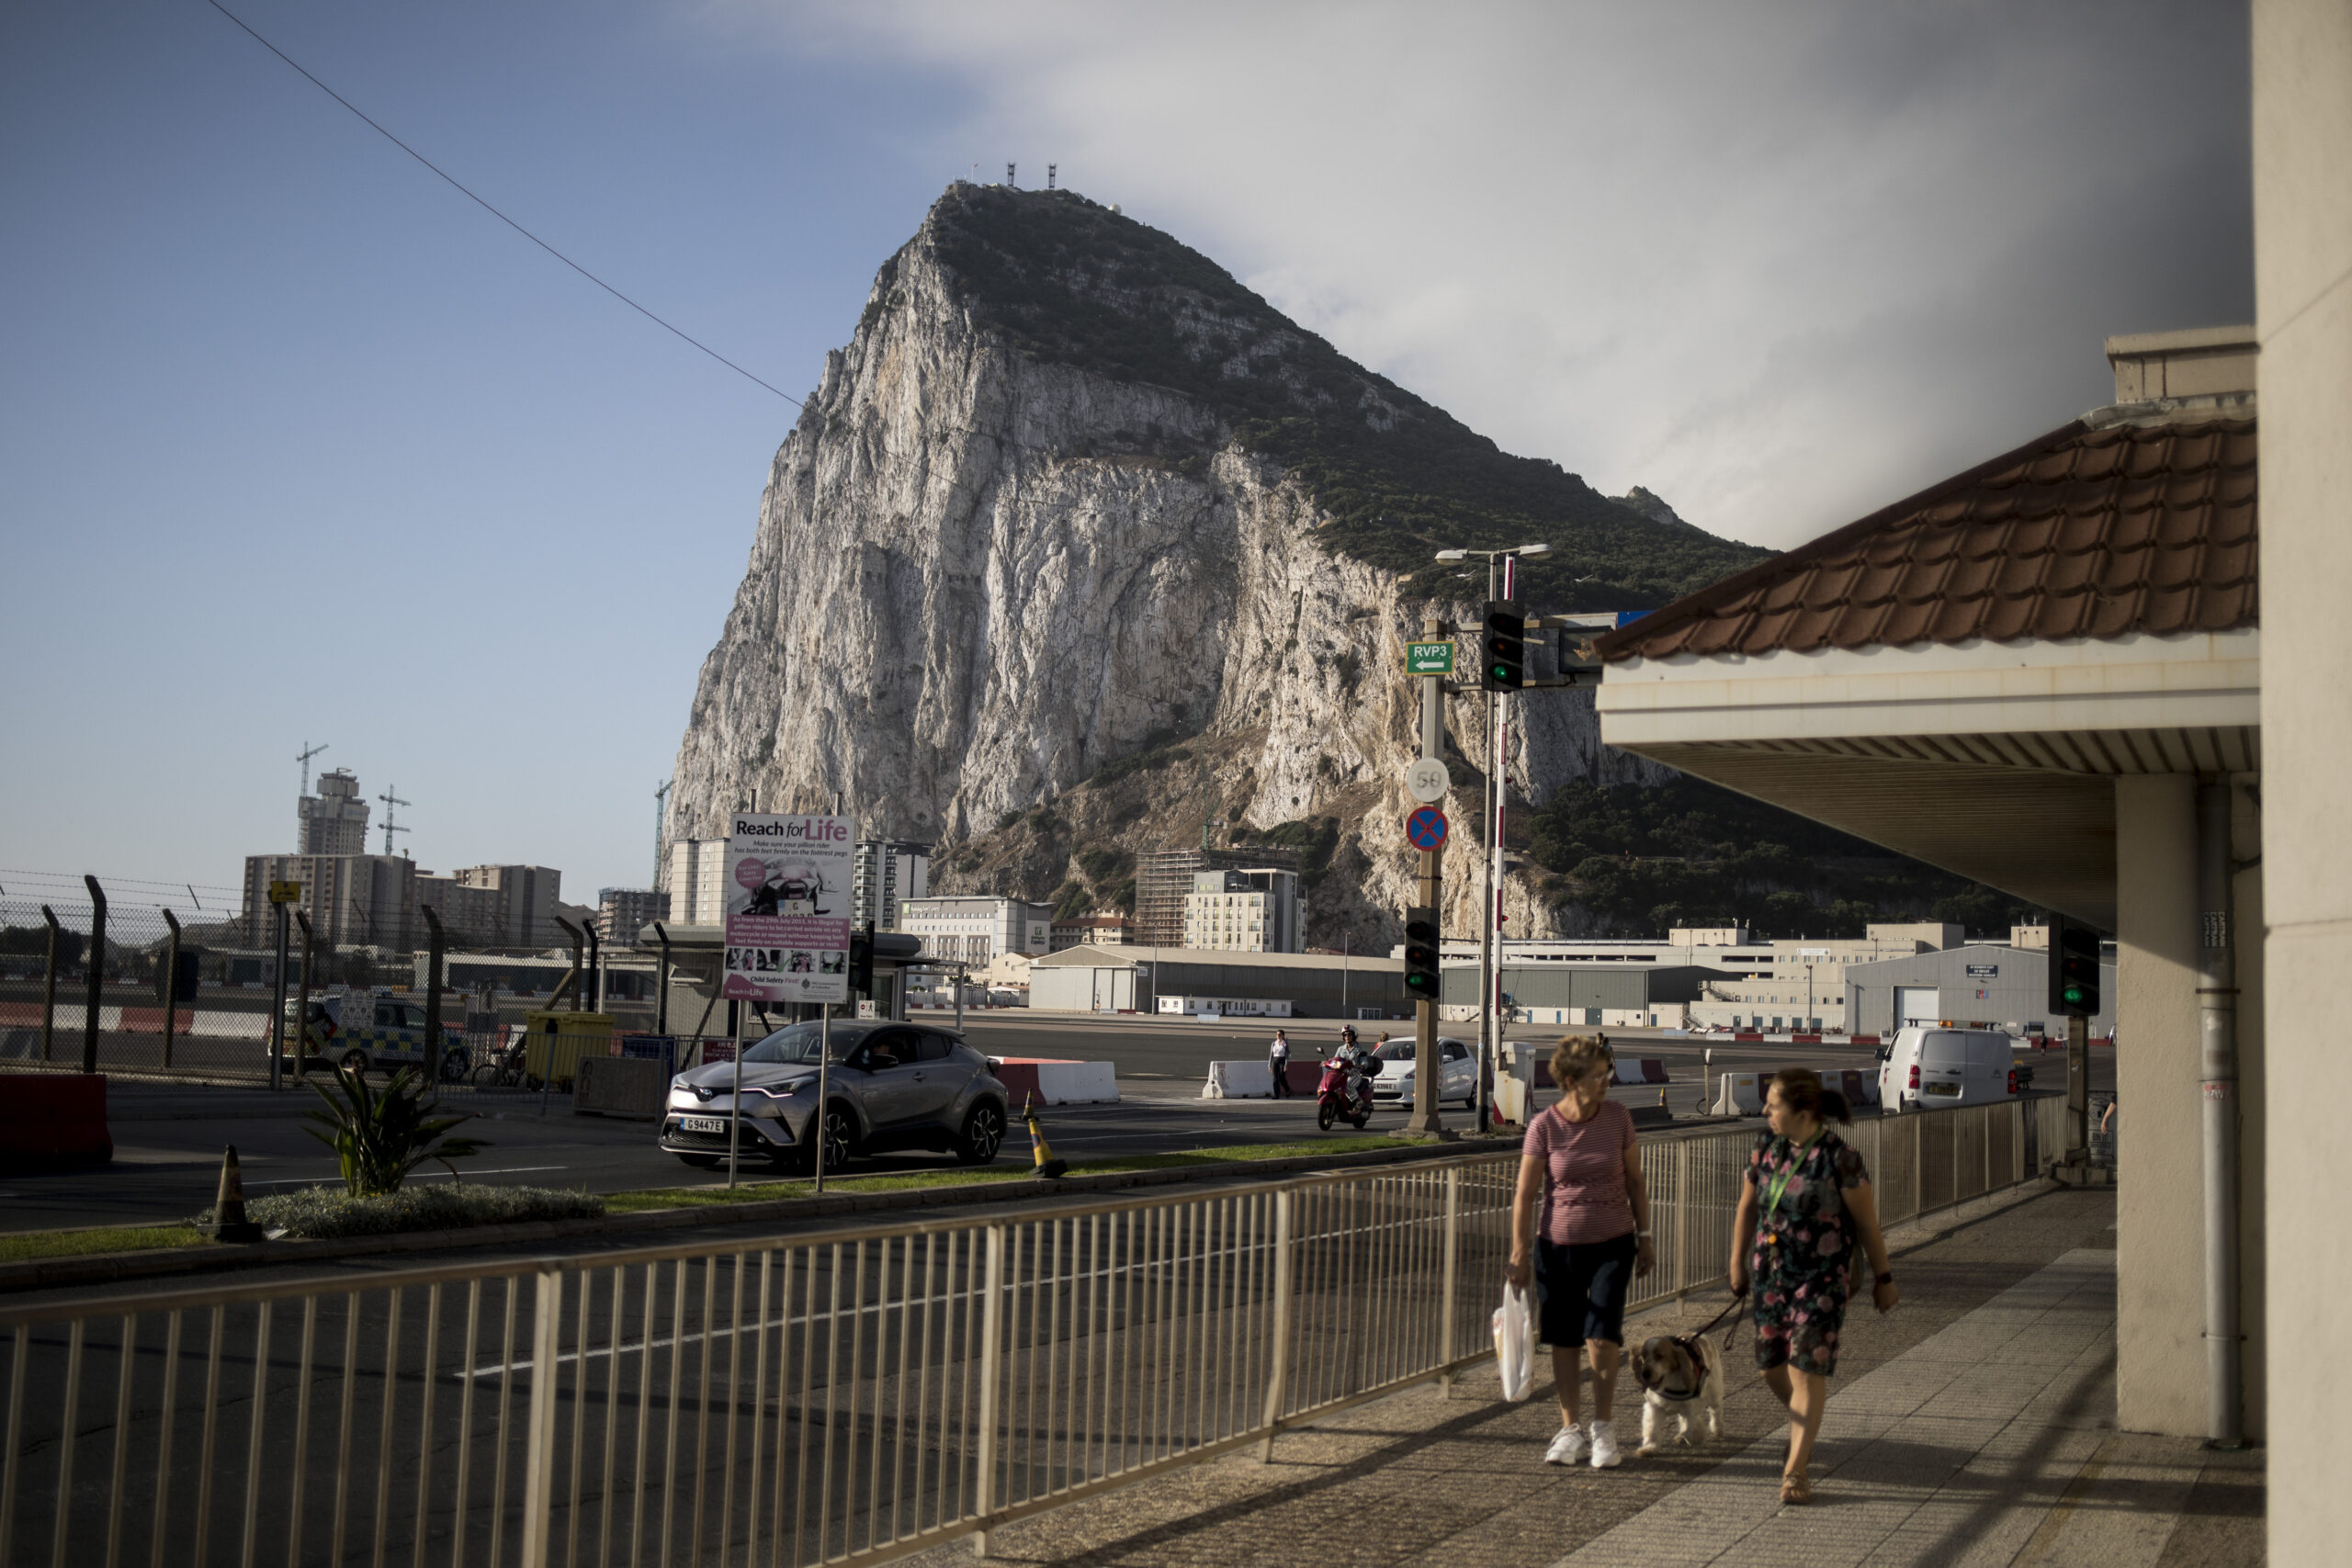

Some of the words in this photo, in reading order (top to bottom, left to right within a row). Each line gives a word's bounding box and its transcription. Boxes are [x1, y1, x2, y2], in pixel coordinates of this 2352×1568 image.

[1414, 646, 1447, 658] RVP3
[1417, 772, 1442, 788] 50
[736, 820, 784, 836] Reach
[786, 822, 806, 838] for
[805, 818, 848, 841] Life
[793, 902, 798, 910] G
[750, 988, 763, 997] Life
[688, 1120, 720, 1131] G9447E
